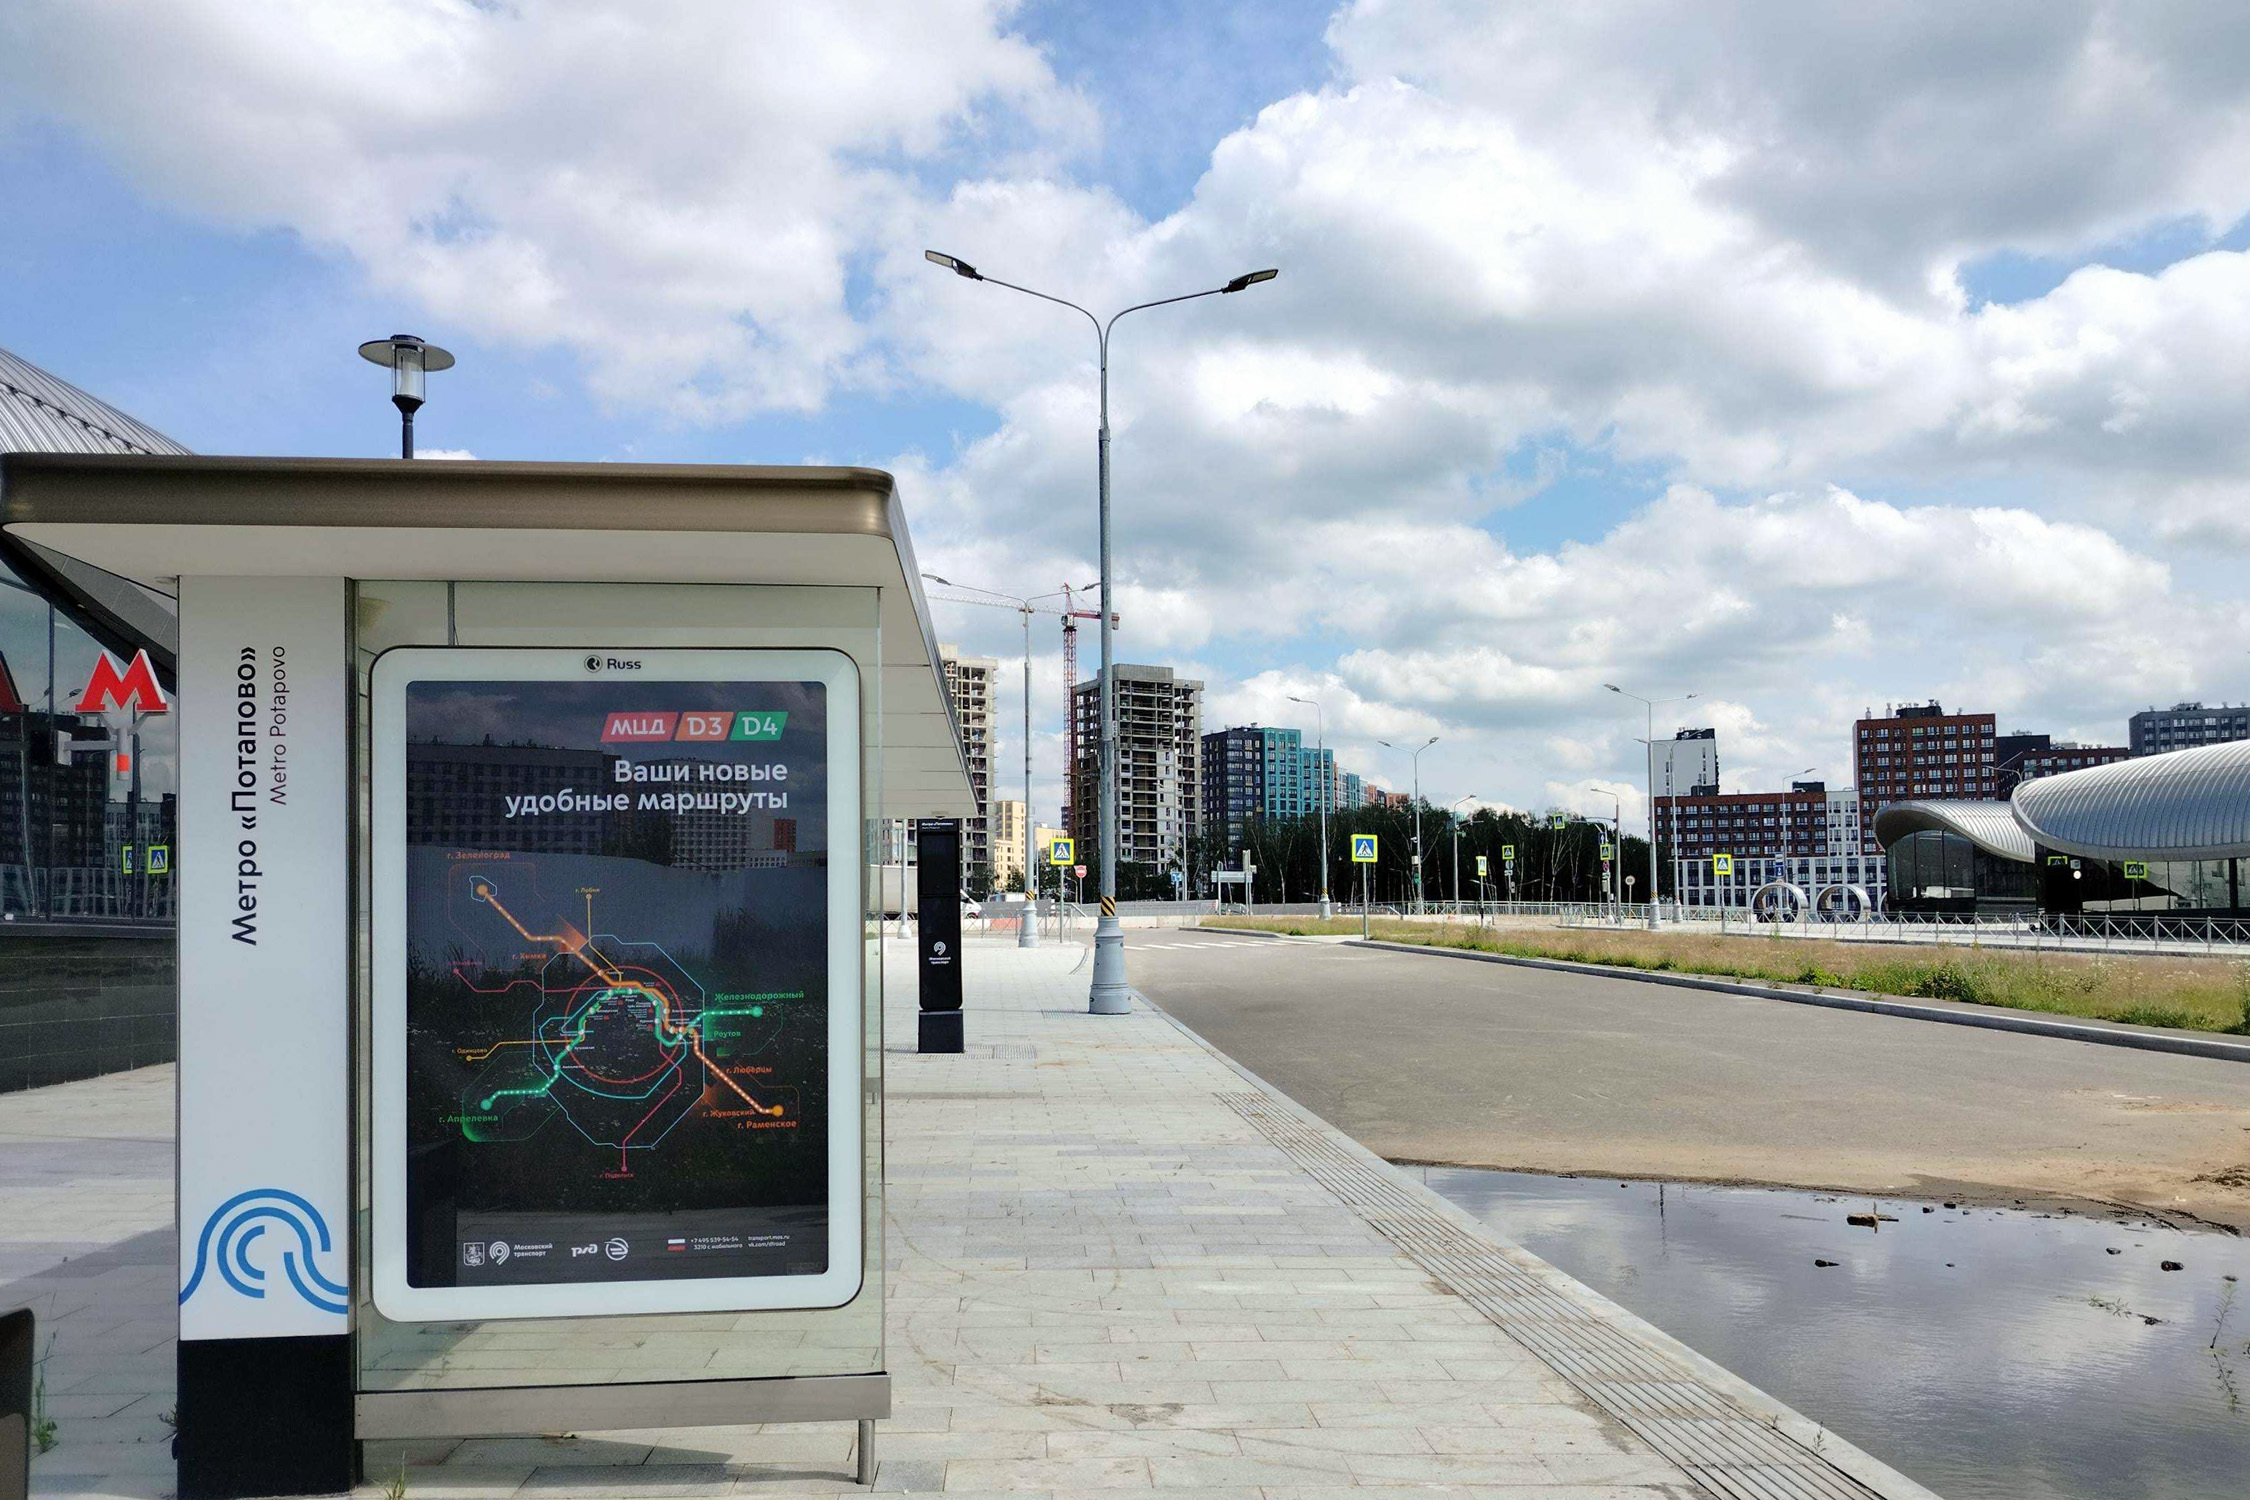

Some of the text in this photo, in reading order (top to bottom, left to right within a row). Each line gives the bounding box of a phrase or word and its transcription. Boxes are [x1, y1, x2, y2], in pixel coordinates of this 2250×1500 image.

[606, 658, 642, 670] Russ
[269, 645, 291, 806] Metro Potapovo
[610, 716, 779, 736] МЦД D3 D4
[614, 760, 789, 782] Ваши новые
[231, 645, 264, 946] Метро «Потапово»
[505, 789, 788, 818] удобные маршруты
[714, 990, 805, 1001] Железнодорожный
[447, 1114, 499, 1124] Апрелевка
[746, 1119, 797, 1129] Раменское
[513, 1243, 553, 1251] Московский
[513, 1250, 546, 1259] транспорт
